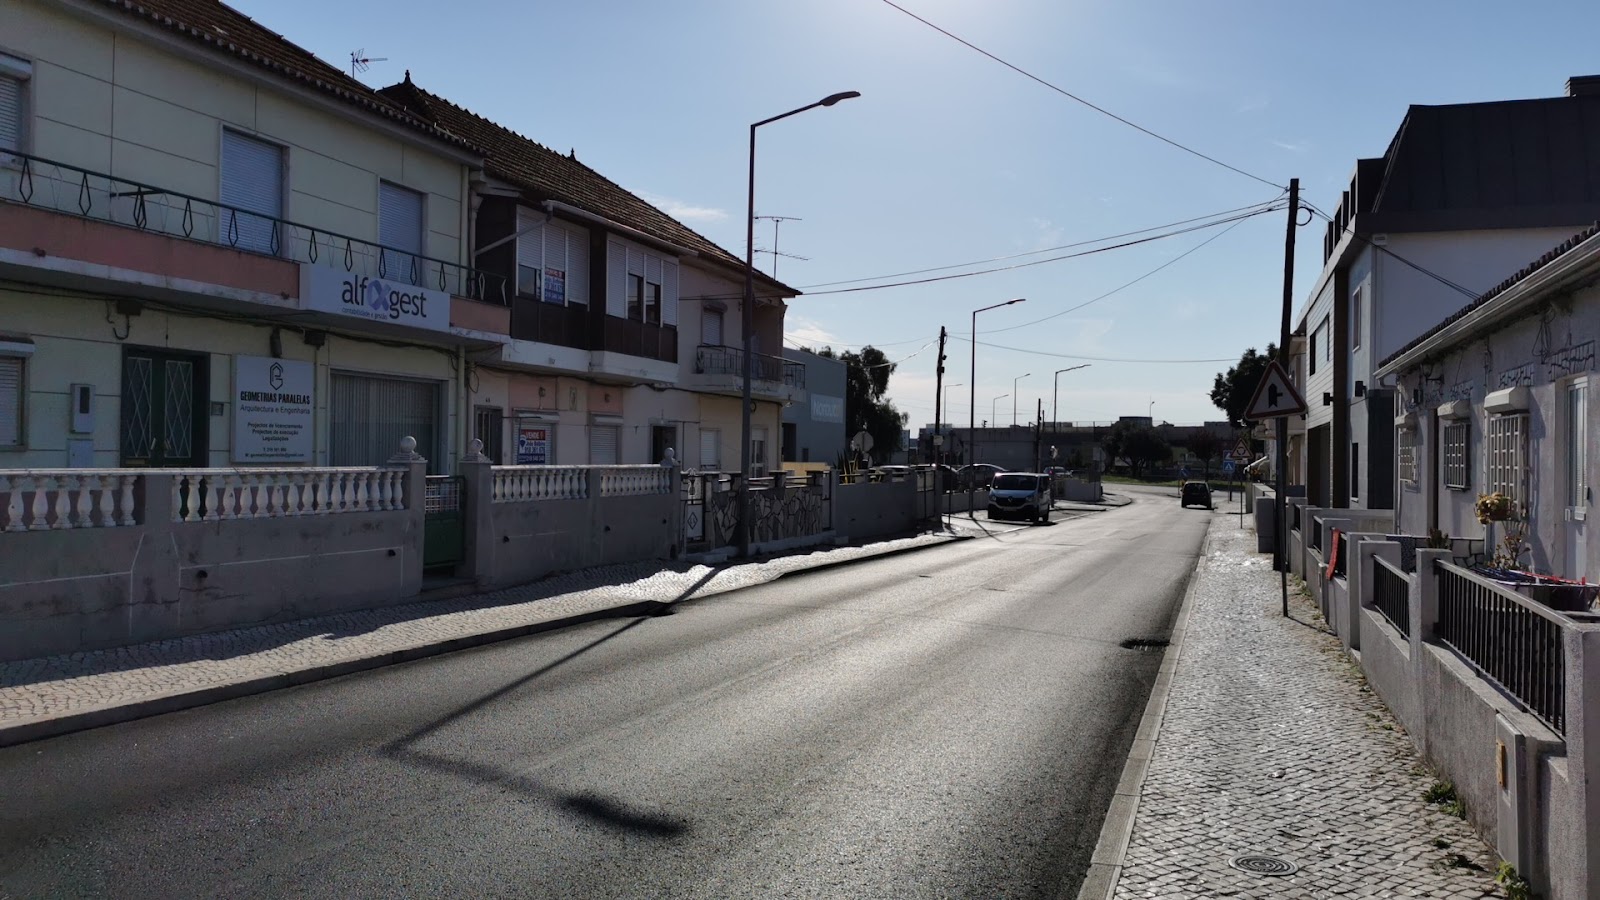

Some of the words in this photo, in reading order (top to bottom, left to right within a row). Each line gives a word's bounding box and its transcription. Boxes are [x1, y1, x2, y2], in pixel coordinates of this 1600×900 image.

[240, 391, 277, 403] GEOMETRIAS
[278, 393, 311, 405] PARALELAS
[240, 404, 274, 413] Arquitectura
[280, 406, 311, 415] Engenharia
